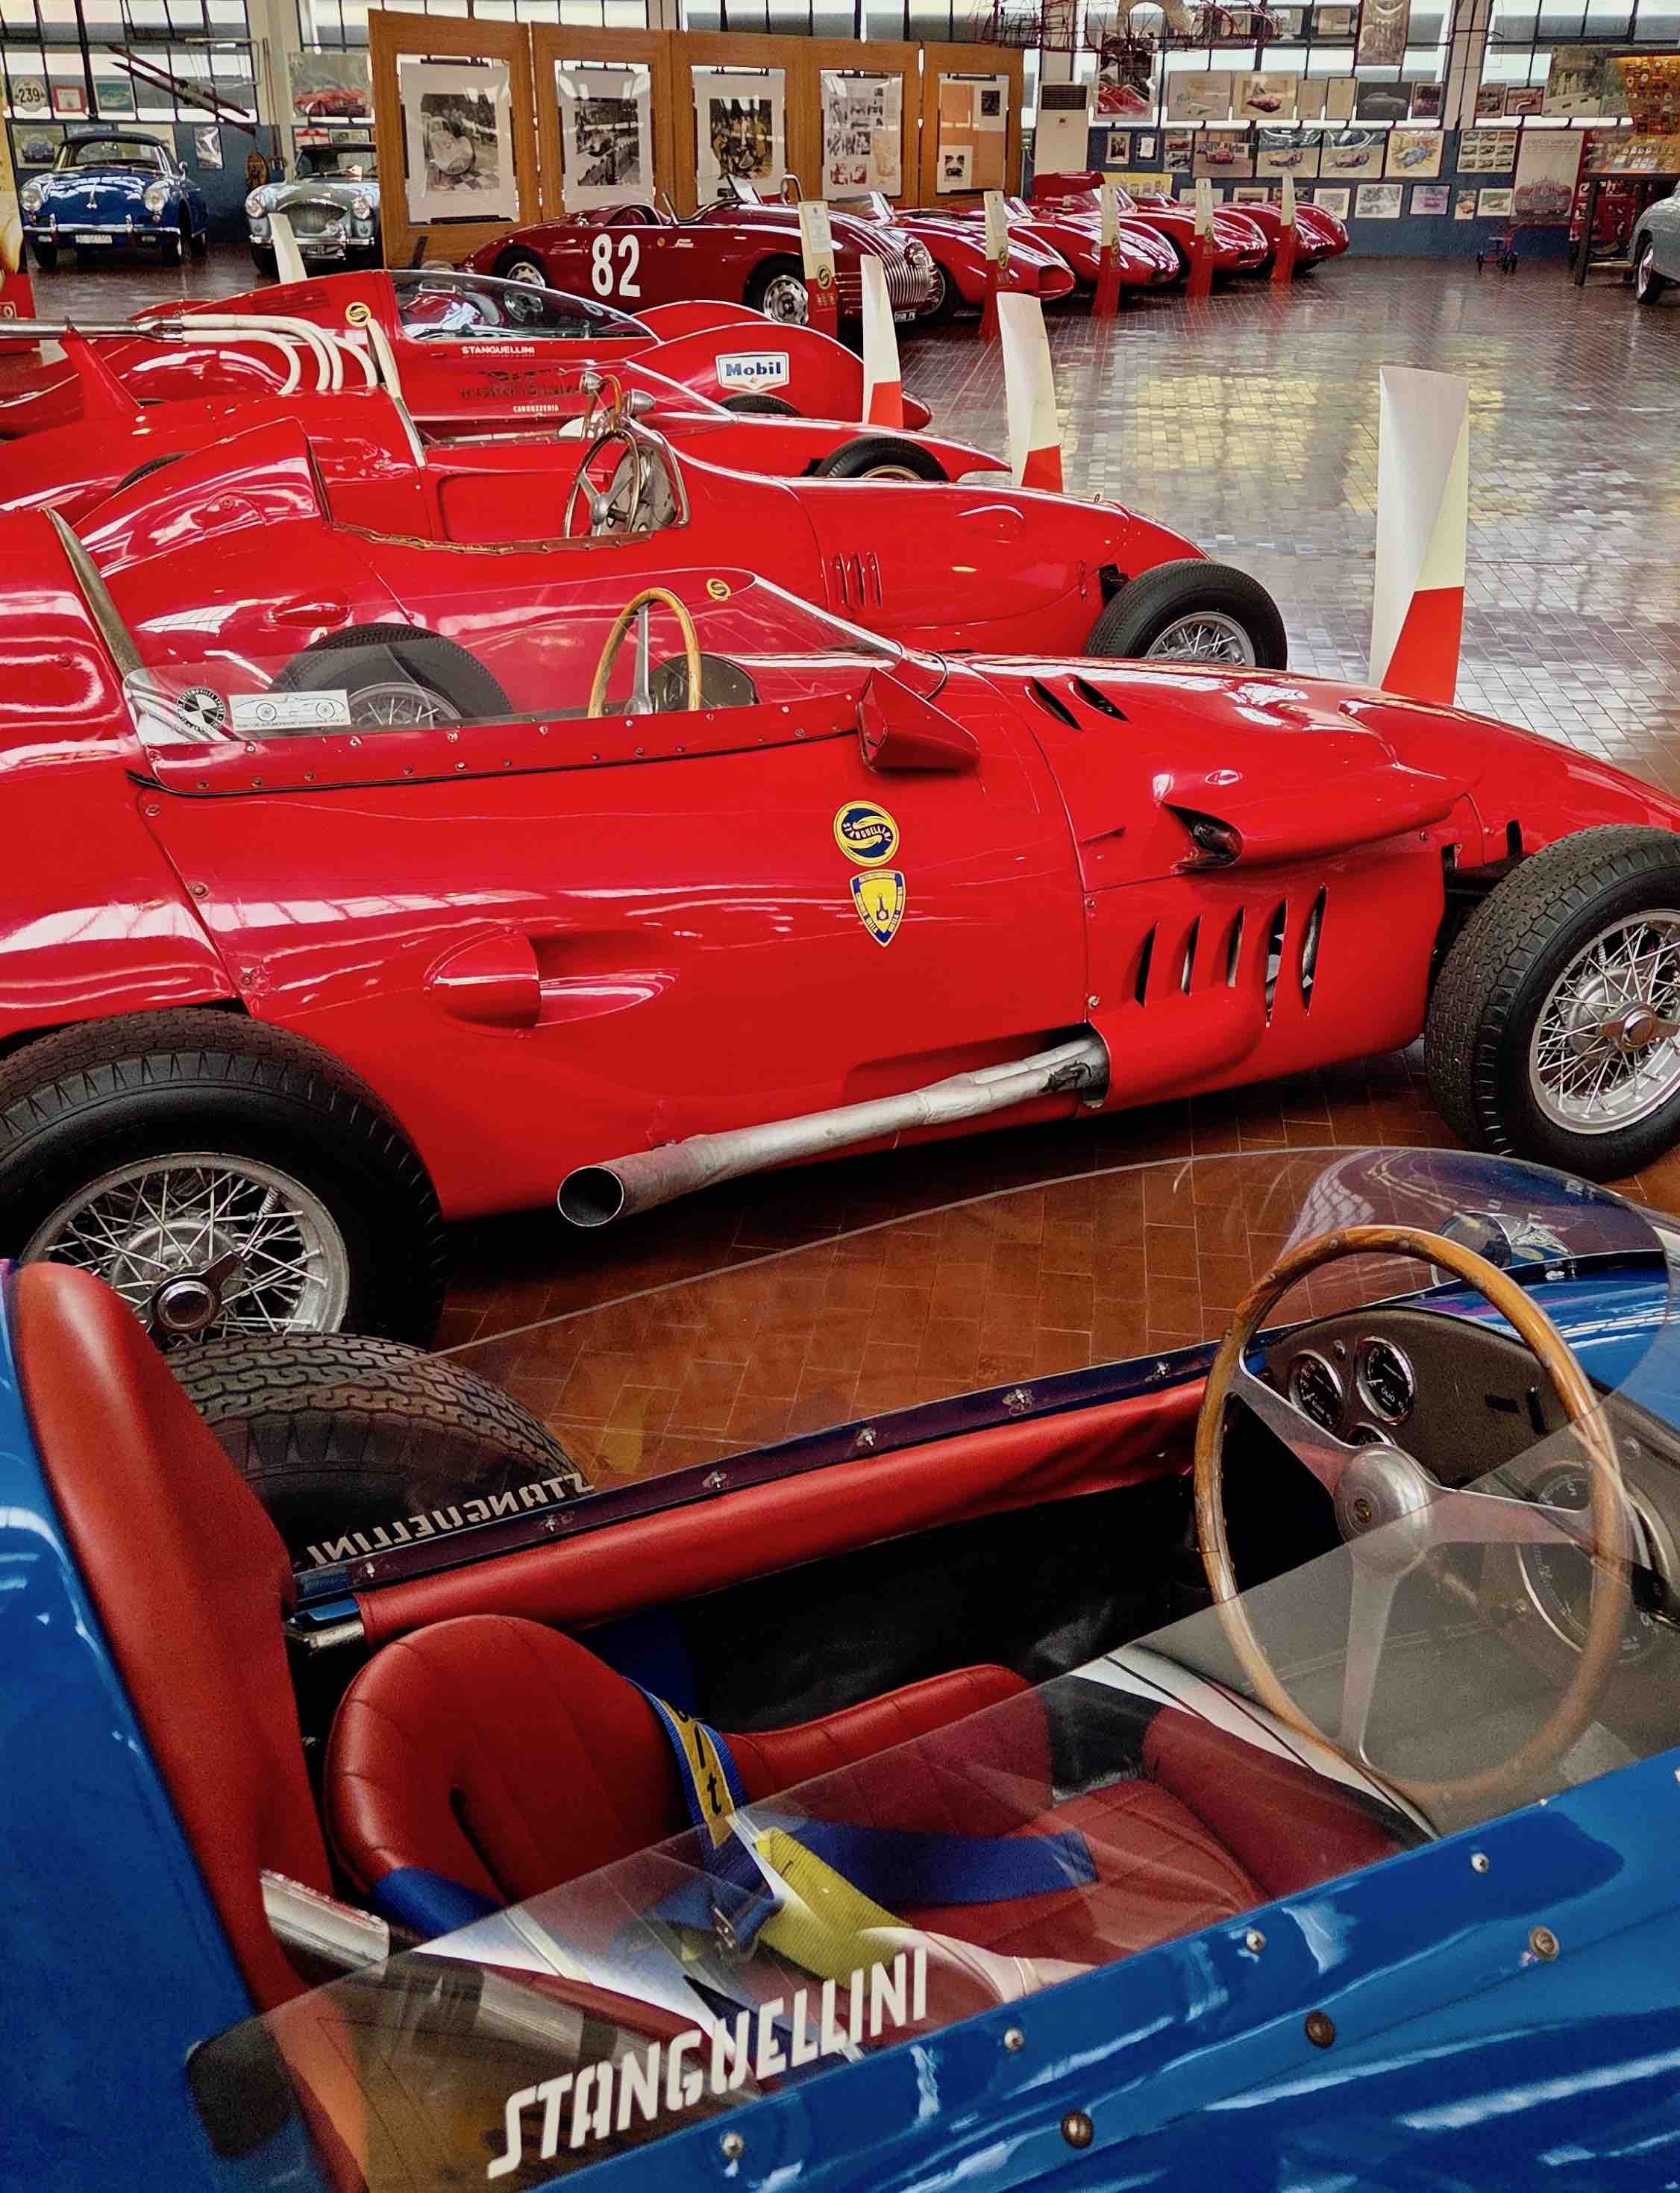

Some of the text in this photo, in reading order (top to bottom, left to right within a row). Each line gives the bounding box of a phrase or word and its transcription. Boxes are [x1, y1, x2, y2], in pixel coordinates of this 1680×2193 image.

[19, 87, 40, 103] 239
[592, 233, 640, 297] 82
[725, 361, 781, 377] Mobil
[487, 1945, 927, 2180] STANGUELLINI
